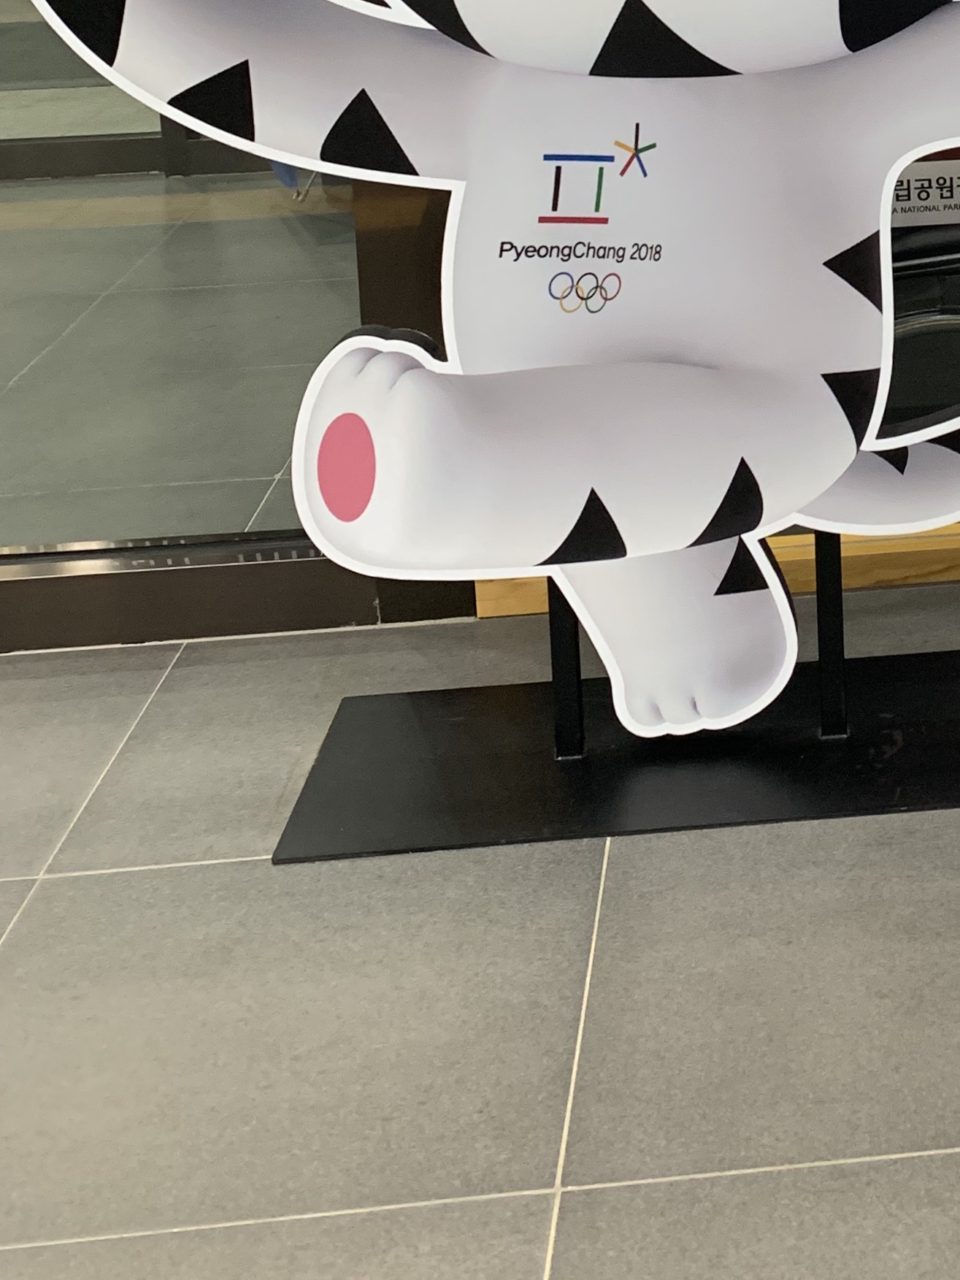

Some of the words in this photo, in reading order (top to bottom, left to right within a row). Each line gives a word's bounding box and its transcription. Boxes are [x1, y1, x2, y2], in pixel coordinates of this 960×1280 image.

[900, 204, 941, 214] NATIONAL
[498, 240, 627, 263] PyeongChang
[629, 242, 663, 262] 2018
